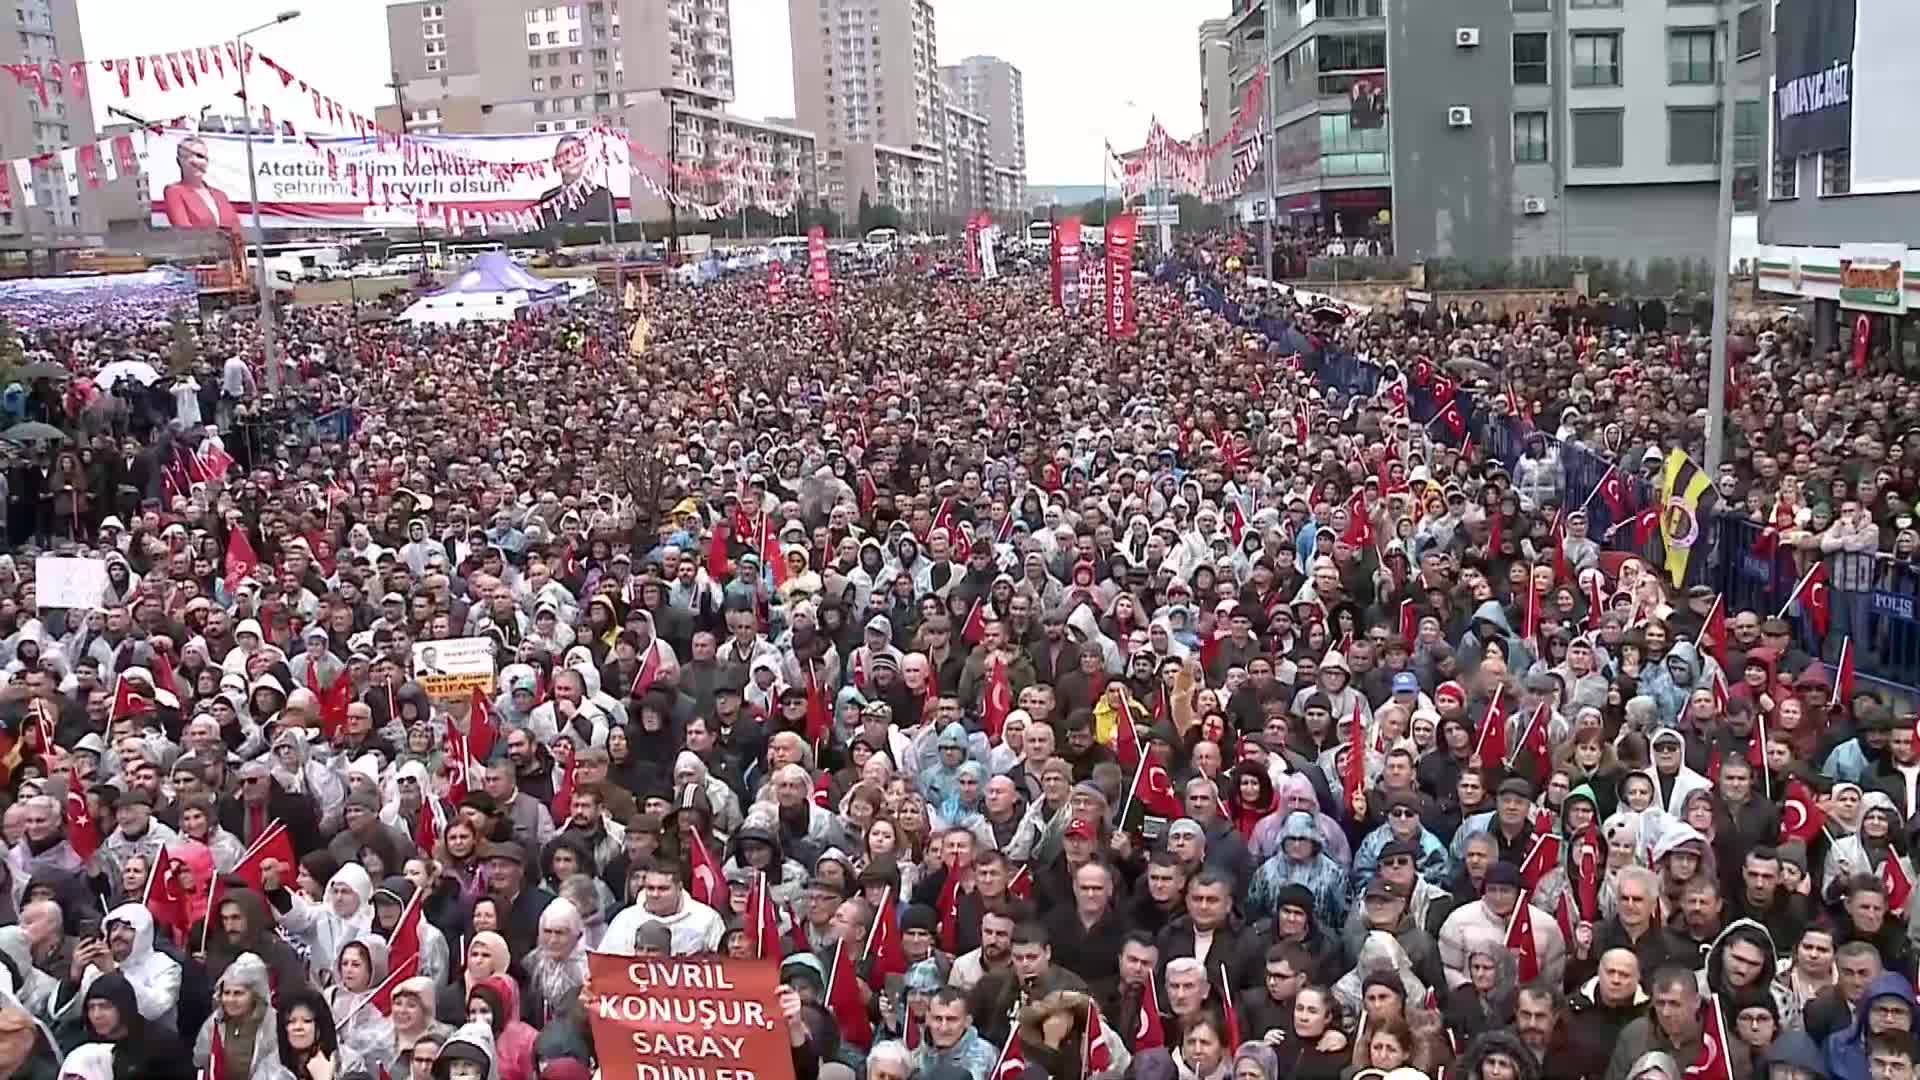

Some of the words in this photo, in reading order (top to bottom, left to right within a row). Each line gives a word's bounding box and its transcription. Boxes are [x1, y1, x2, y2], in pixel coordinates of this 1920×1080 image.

[450, 179, 511, 194] olsun.
[1112, 260, 1126, 330] KEPSUT
[600, 994, 775, 1030] KONUŞUR,
[632, 1032, 745, 1059] SARAY
